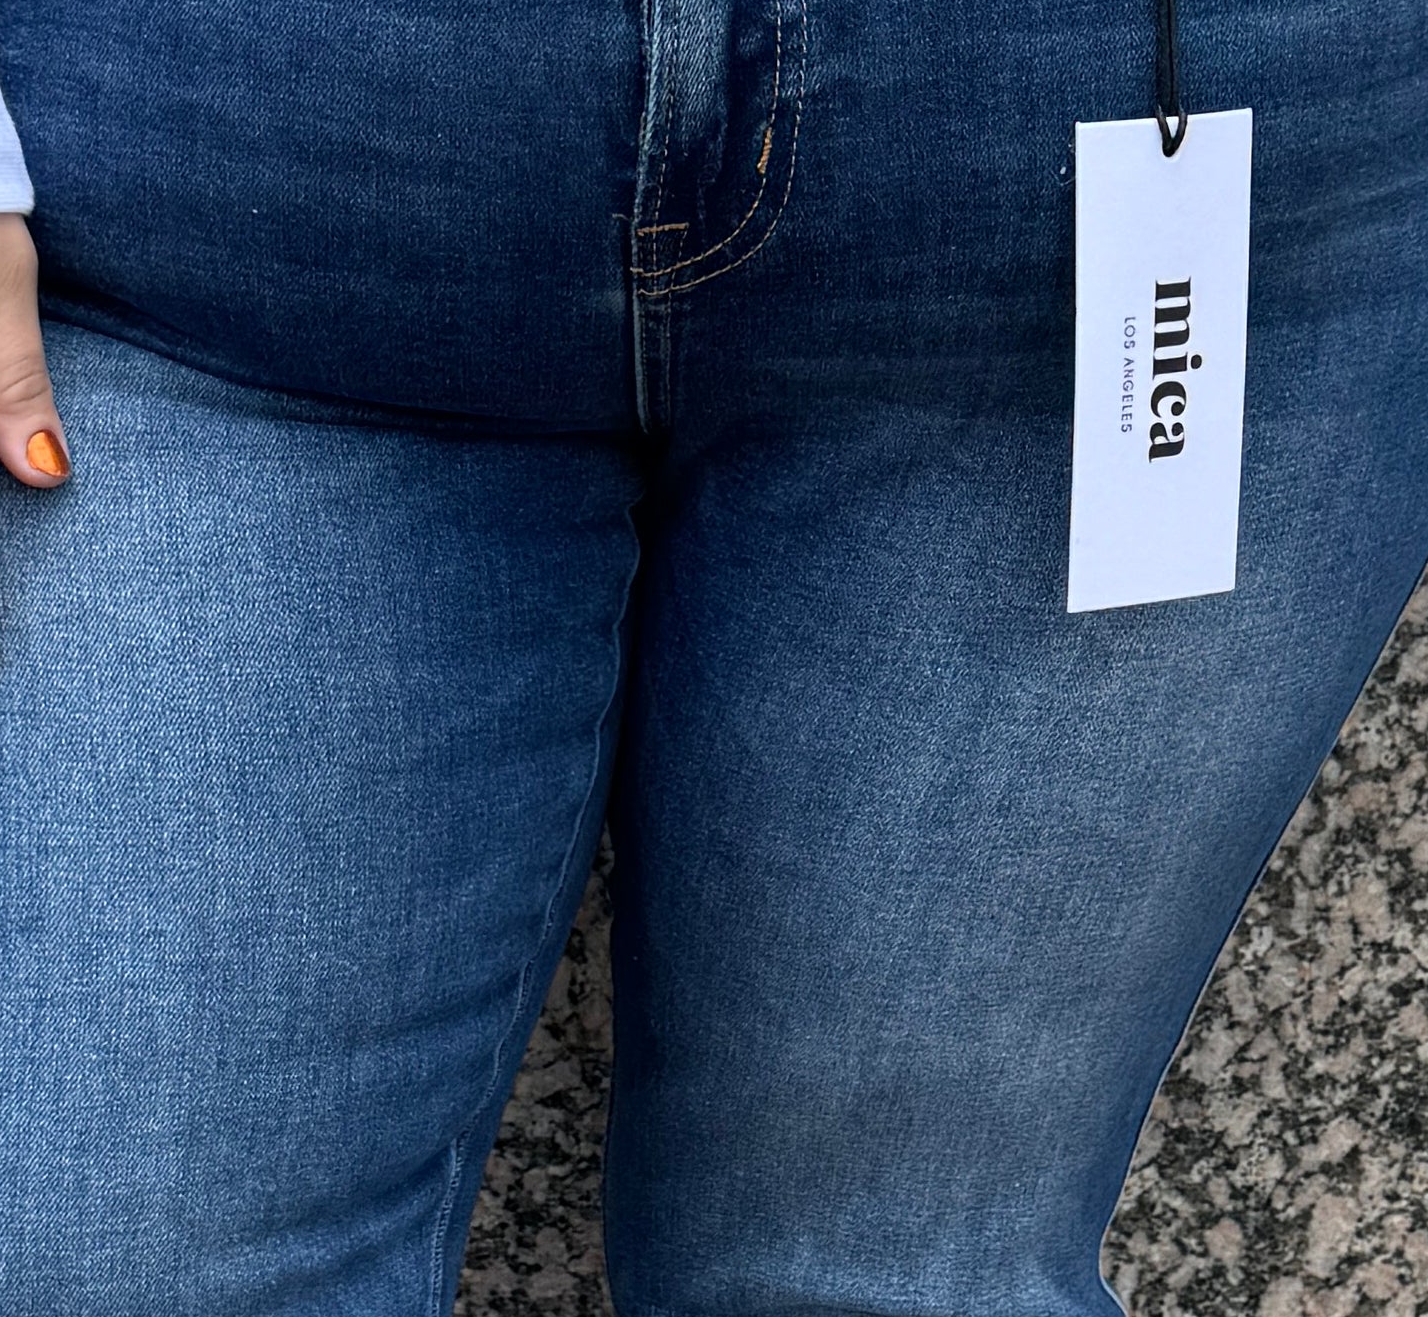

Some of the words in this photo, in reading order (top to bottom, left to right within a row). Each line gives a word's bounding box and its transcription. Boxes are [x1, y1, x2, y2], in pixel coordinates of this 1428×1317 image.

[1123, 316, 1136, 350] LOS
[1148, 276, 1203, 463] mica
[1120, 357, 1135, 434] ANGELES
